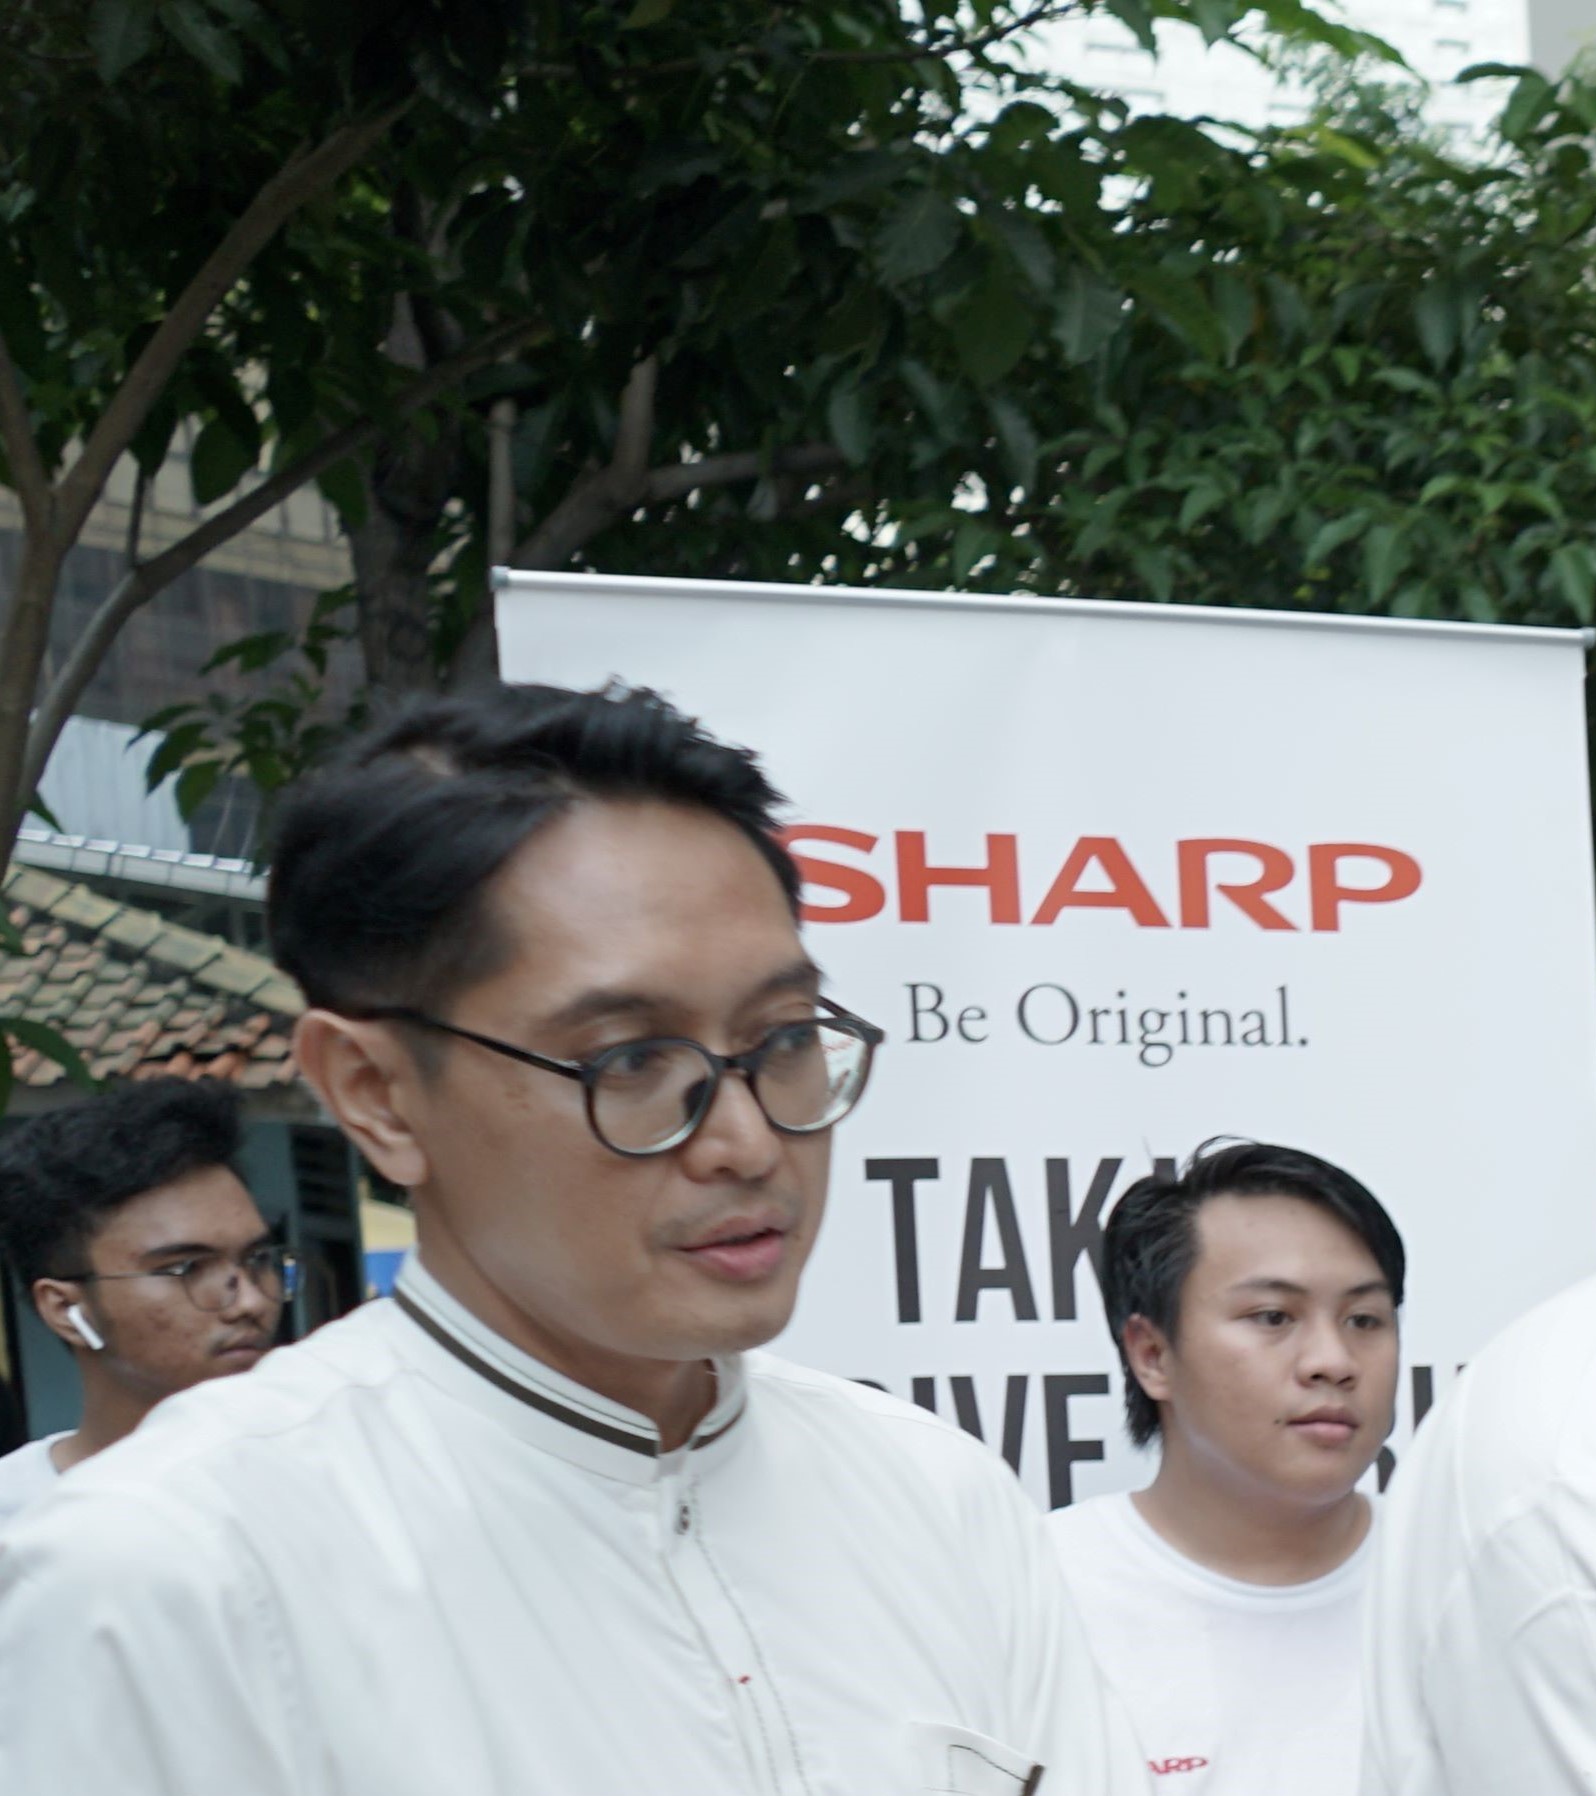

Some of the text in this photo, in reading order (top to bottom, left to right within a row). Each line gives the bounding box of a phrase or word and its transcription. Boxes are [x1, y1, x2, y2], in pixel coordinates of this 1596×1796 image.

[777, 824, 1423, 932] SHARP
[904, 982, 1310, 1068] Be Original.
[865, 1156, 1182, 1325] TAK
